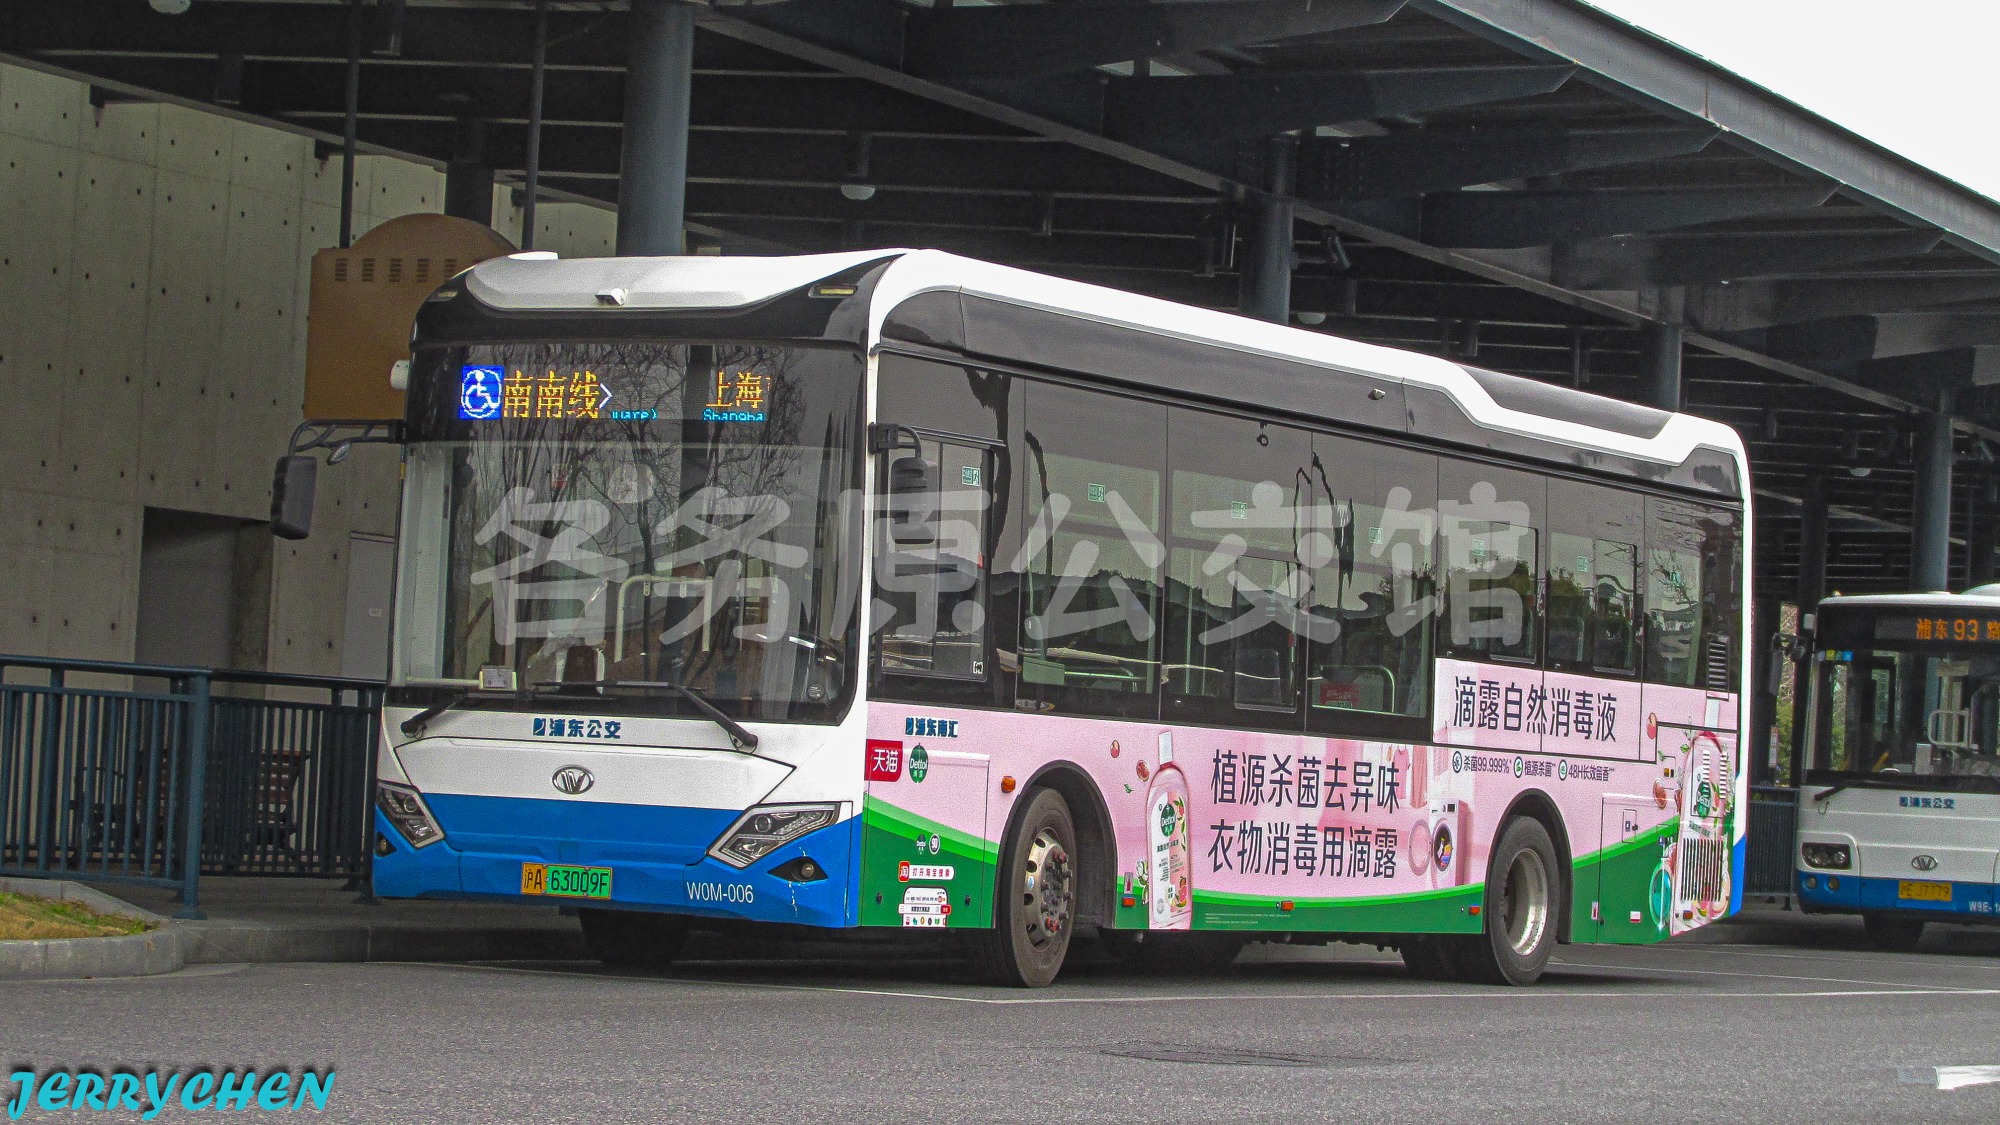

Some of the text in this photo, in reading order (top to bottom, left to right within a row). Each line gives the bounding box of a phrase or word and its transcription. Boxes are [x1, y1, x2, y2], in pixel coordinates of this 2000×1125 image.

[503, 370, 600, 419] 南南线
[705, 370, 771, 410] 上海
[1953, 618, 1979, 641] 93
[548, 717, 621, 739] 浦东公交
[1453, 675, 1617, 742] 滴露自然消毒液
[872, 749, 899, 773] 天猫
[909, 758, 927, 770] Dettol
[1211, 749, 1400, 814] 植源杀菌去异味
[1207, 819, 1398, 879] 衣物消毒用滴露
